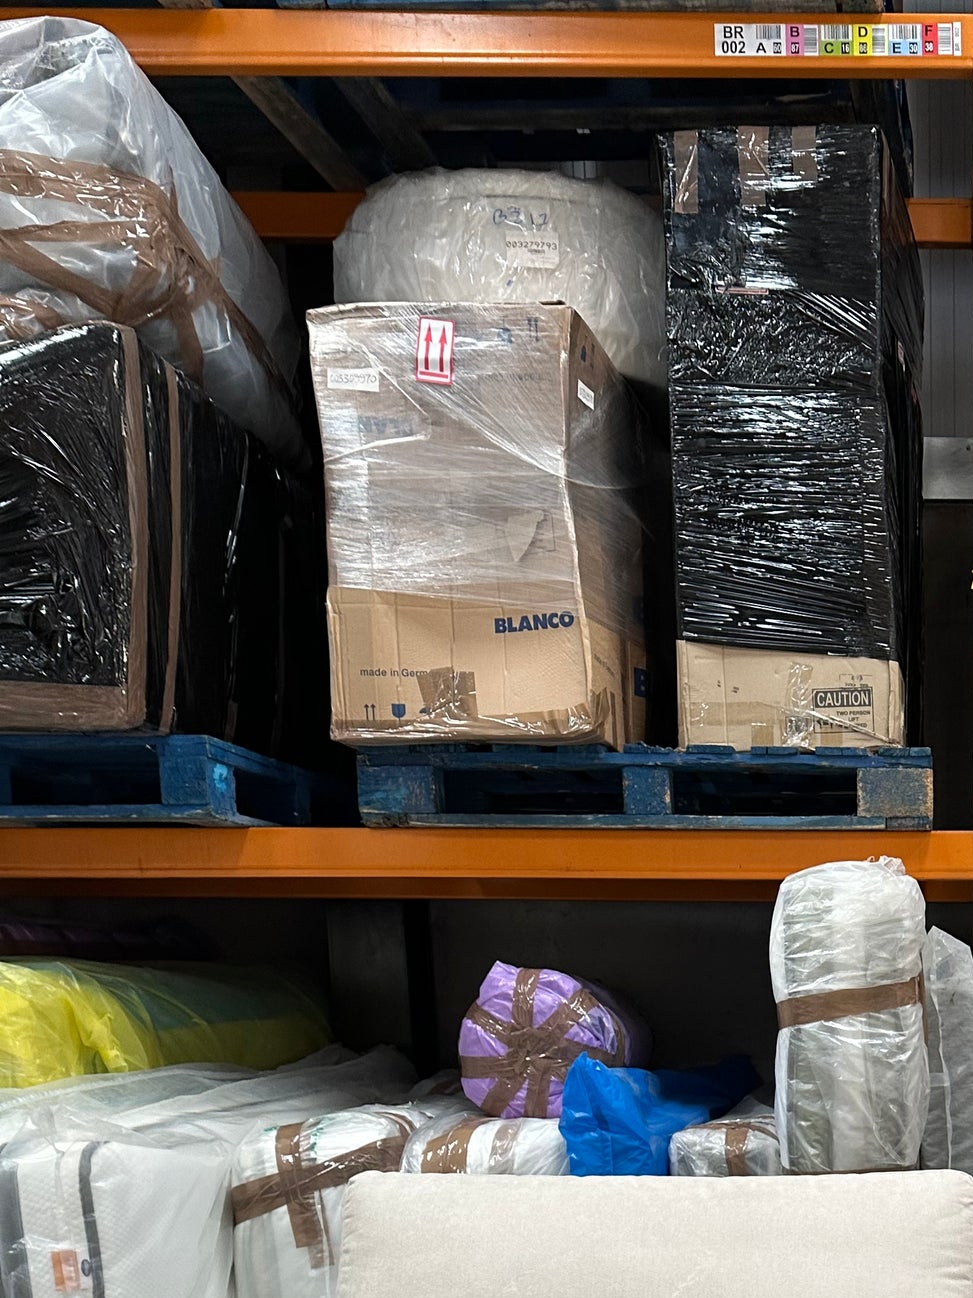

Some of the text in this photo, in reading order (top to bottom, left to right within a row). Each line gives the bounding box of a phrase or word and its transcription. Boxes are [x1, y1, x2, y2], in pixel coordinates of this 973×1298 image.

[723, 26, 744, 39] BR
[790, 27, 800, 37] B
[858, 27, 868, 37] D
[924, 25, 933, 36] F
[722, 41, 746, 54] 002
[756, 42, 767, 54] A
[824, 42, 834, 54] C
[892, 43, 902, 54] E
[494, 611, 575, 634] BLANCO
[359, 667, 430, 677] made in Germ
[816, 690, 869, 707] CAUTION
